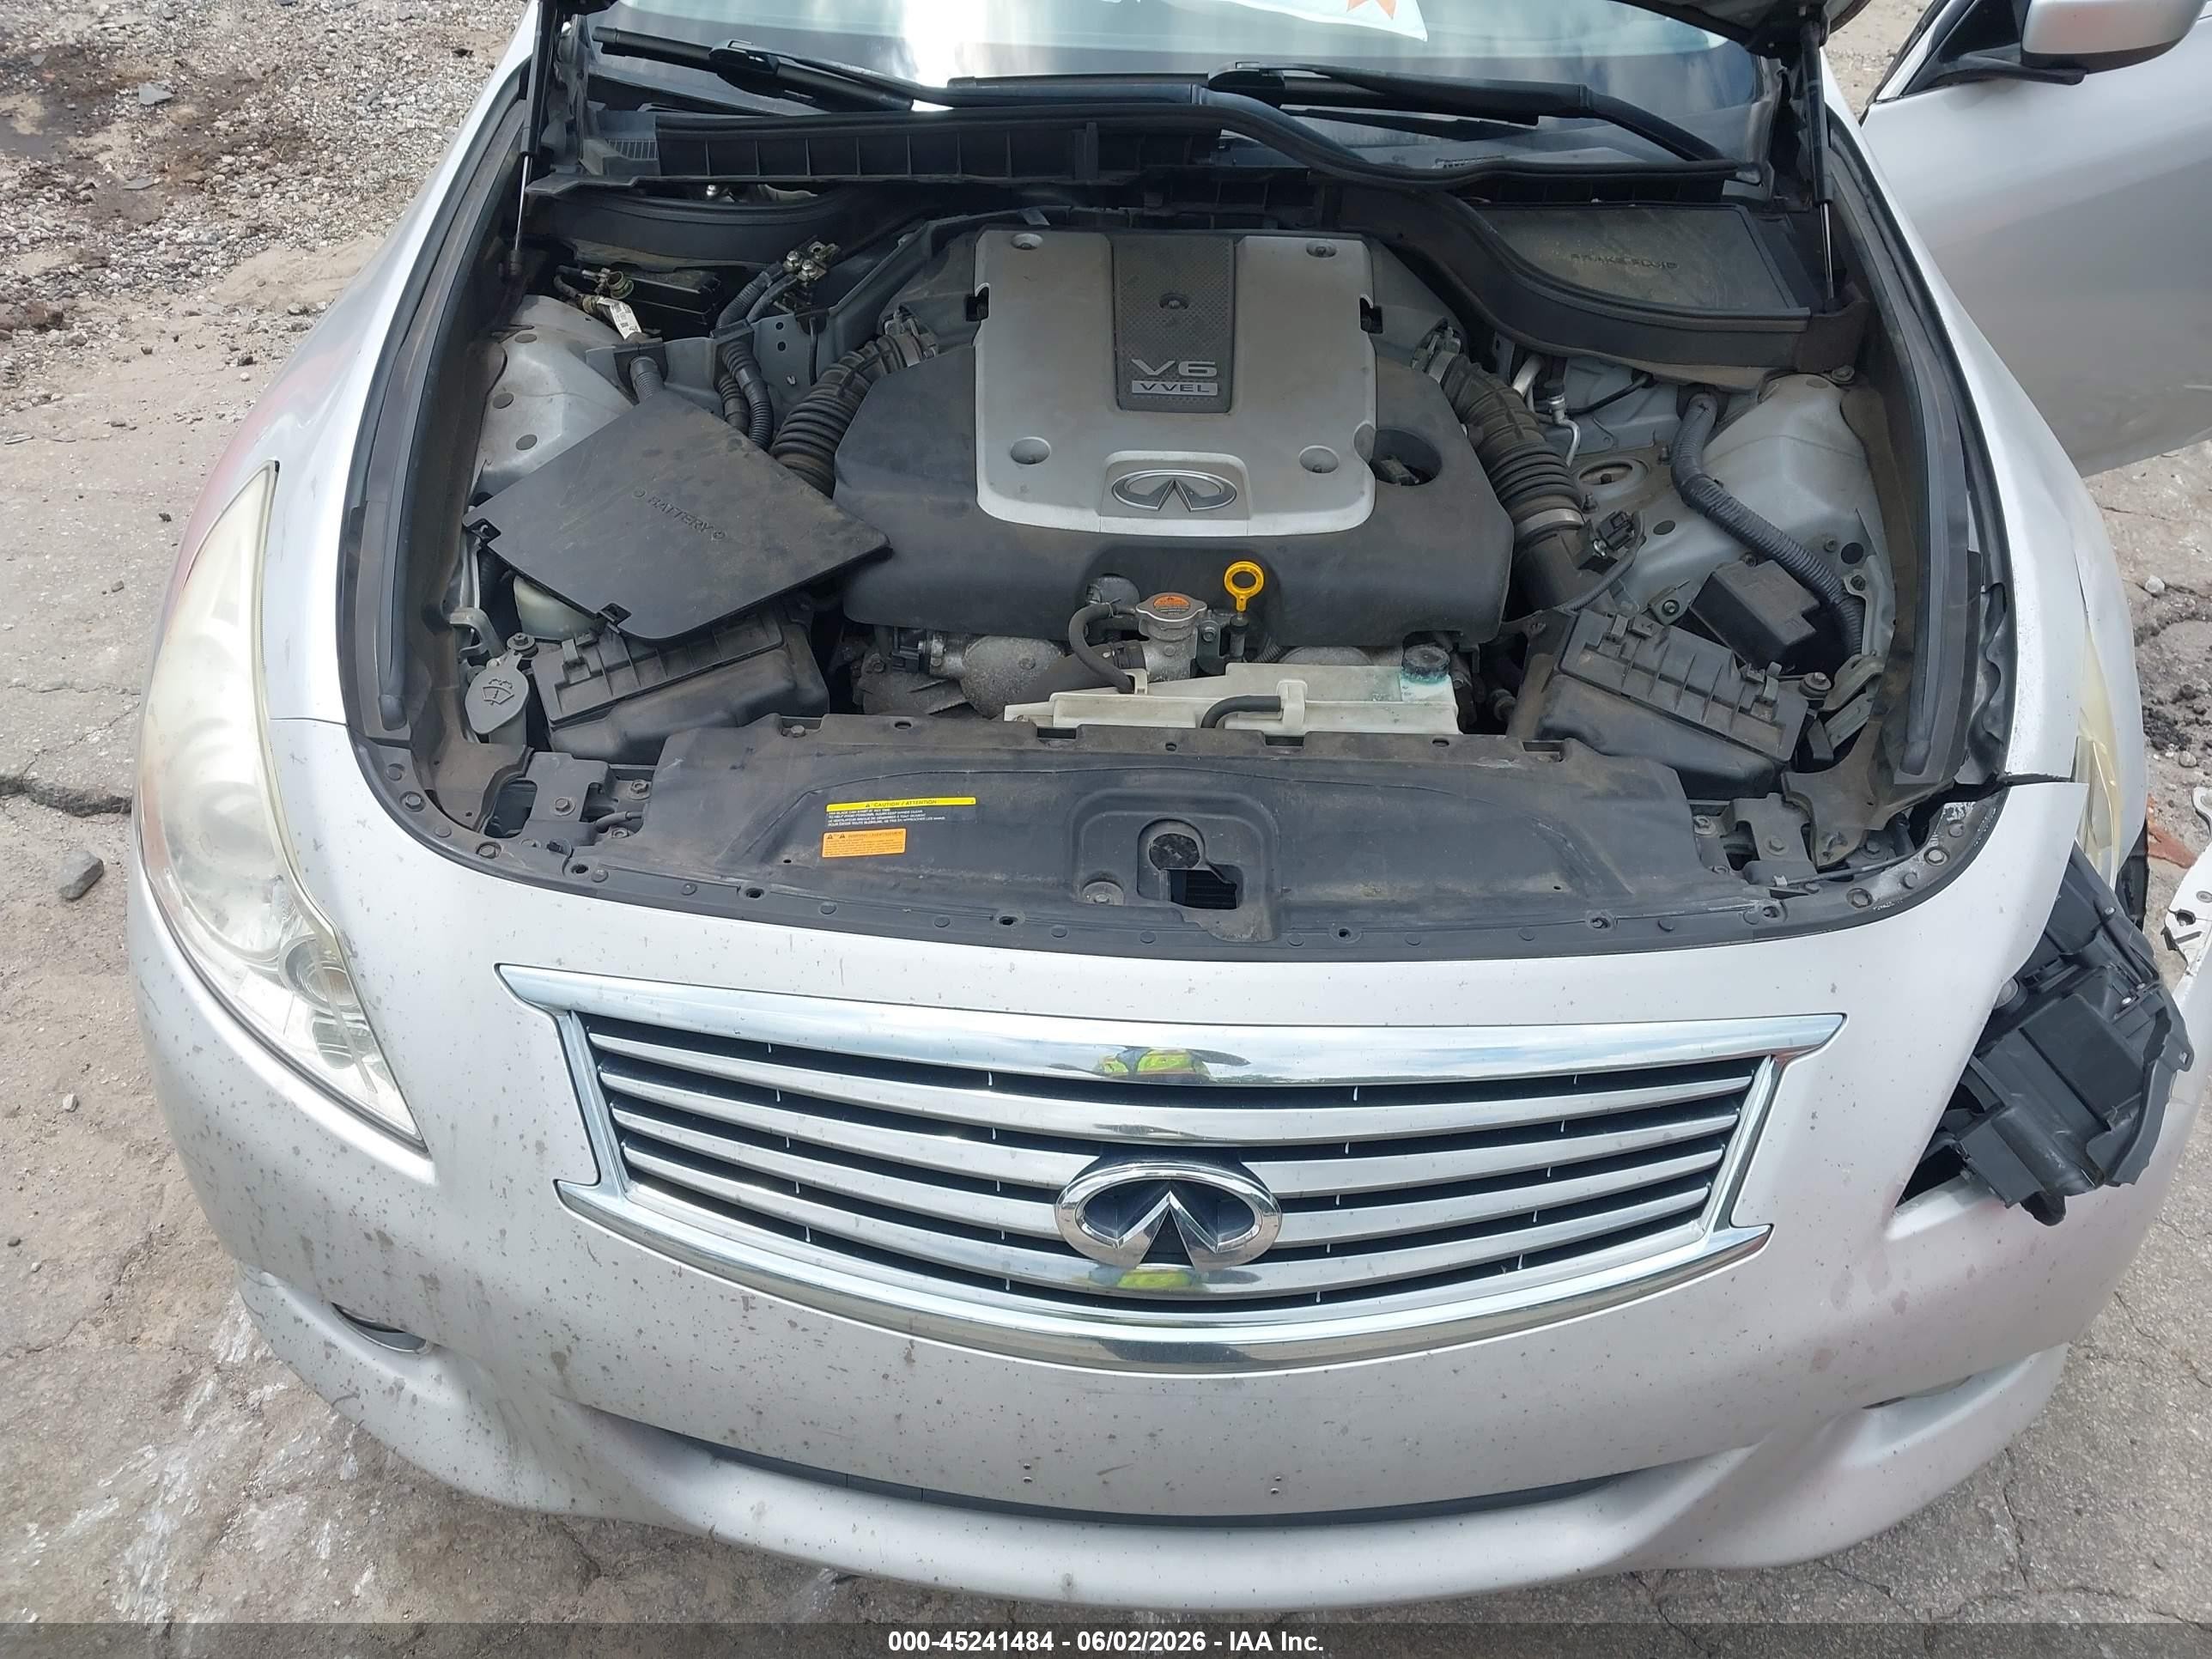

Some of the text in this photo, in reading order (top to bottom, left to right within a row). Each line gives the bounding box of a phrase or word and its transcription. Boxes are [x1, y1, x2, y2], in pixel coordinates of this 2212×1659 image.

[1131, 358, 1218, 378] V6
[1139, 382, 1211, 393] VVEL
[647, 495, 714, 533] BATTERY
